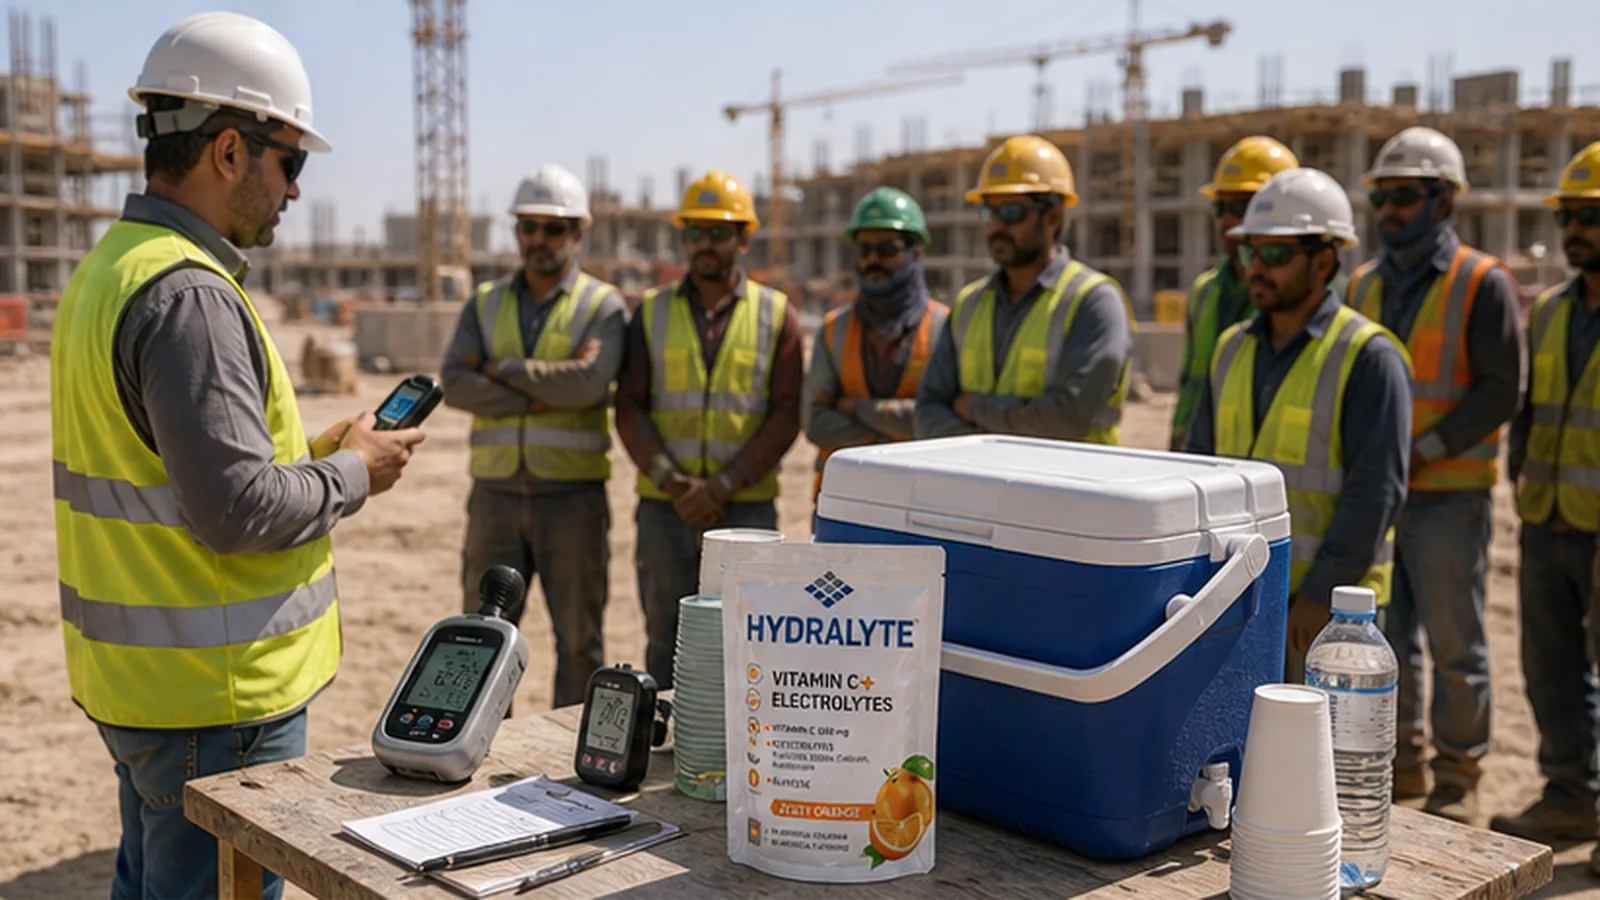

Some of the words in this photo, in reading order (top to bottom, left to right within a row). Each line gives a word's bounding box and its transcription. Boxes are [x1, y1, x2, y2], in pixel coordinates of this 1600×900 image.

[747, 613, 915, 648] HYDRALYTE
[772, 670, 842, 689] VITAMIN
[771, 691, 893, 712] ELECTROLYTES
